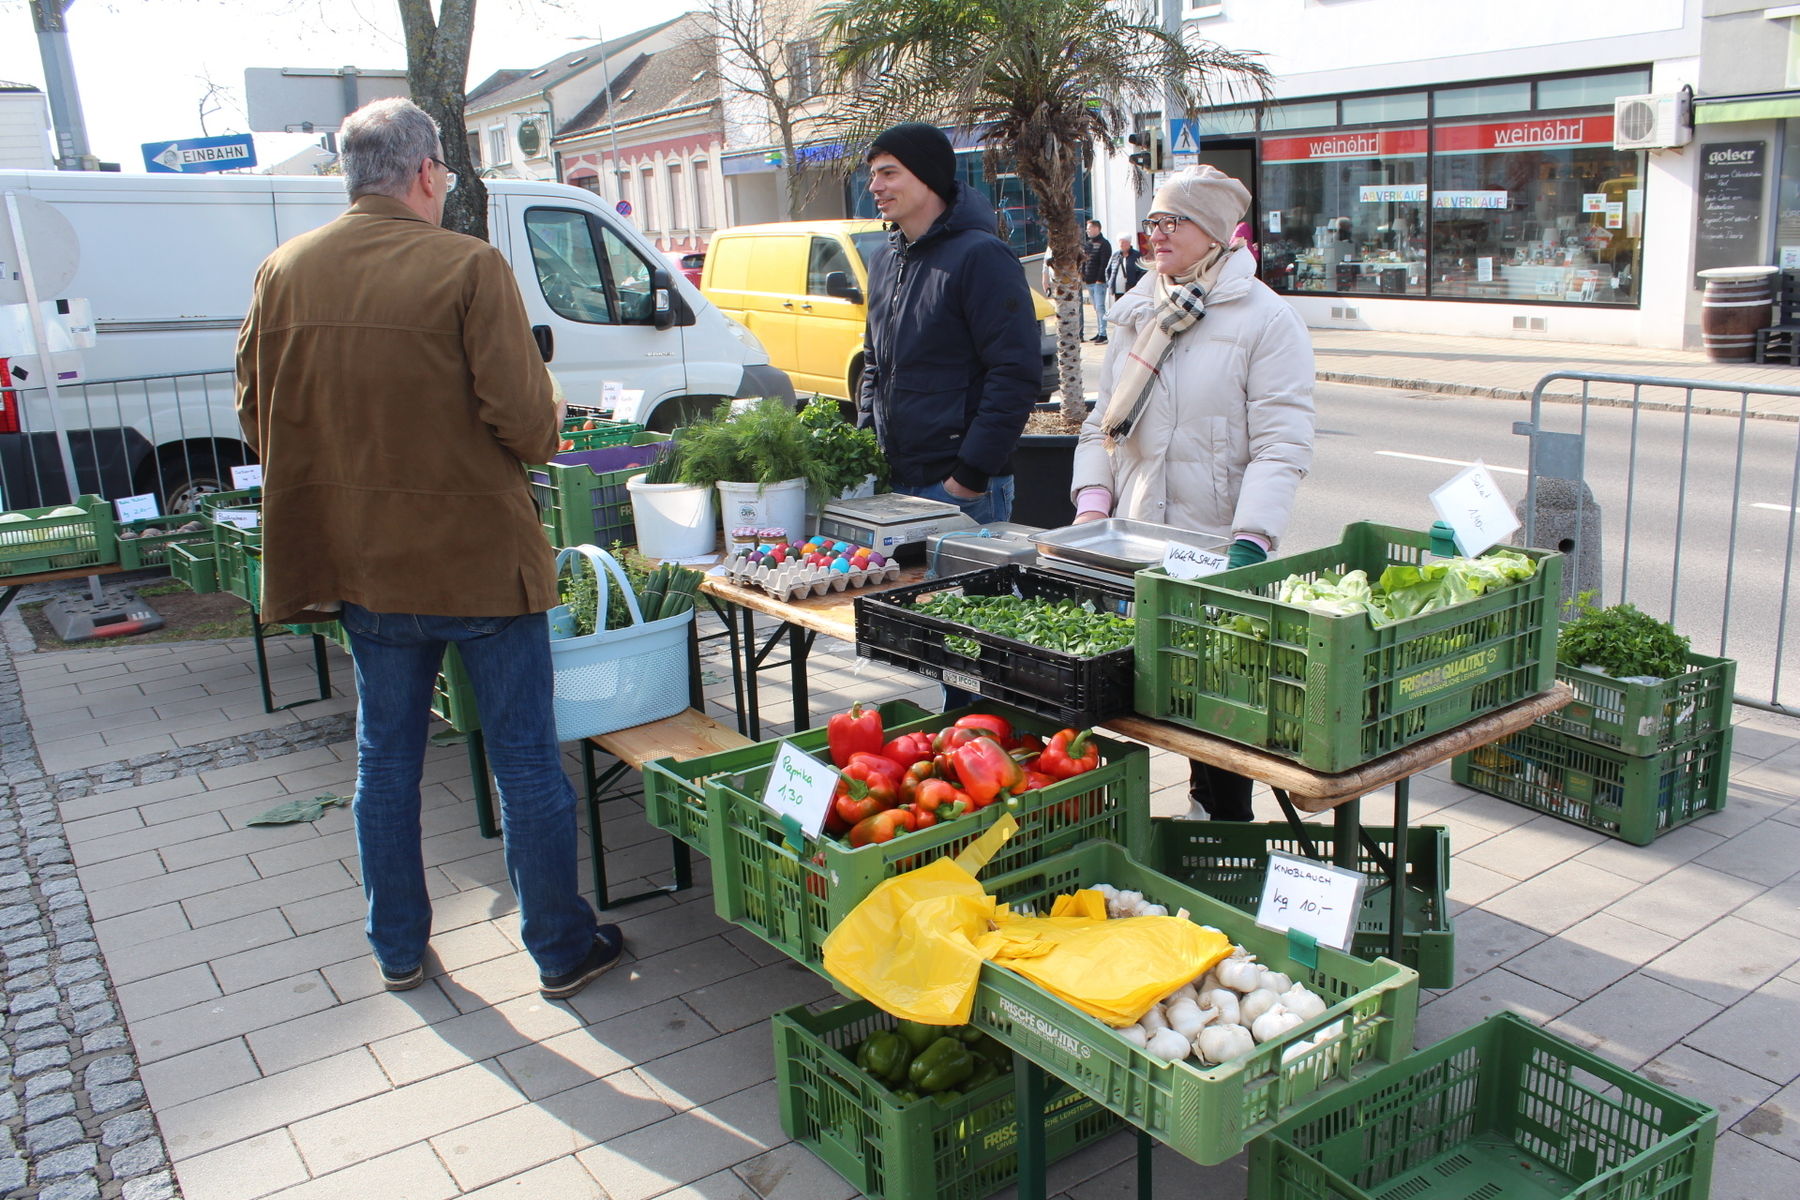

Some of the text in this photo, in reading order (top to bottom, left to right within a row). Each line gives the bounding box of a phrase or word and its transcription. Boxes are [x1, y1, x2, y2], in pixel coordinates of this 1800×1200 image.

[182, 145, 244, 163] EINBAHN
[1708, 149, 1756, 165] golser
[1399, 667, 1441, 696] FRISCHE
[782, 755, 814, 788] Paprika
[777, 783, 804, 806] 1,30
[1273, 863, 1332, 886] KNOBLAUCH
[1273, 887, 1290, 913] kg
[1000, 997, 1036, 1026] FRISCHE
